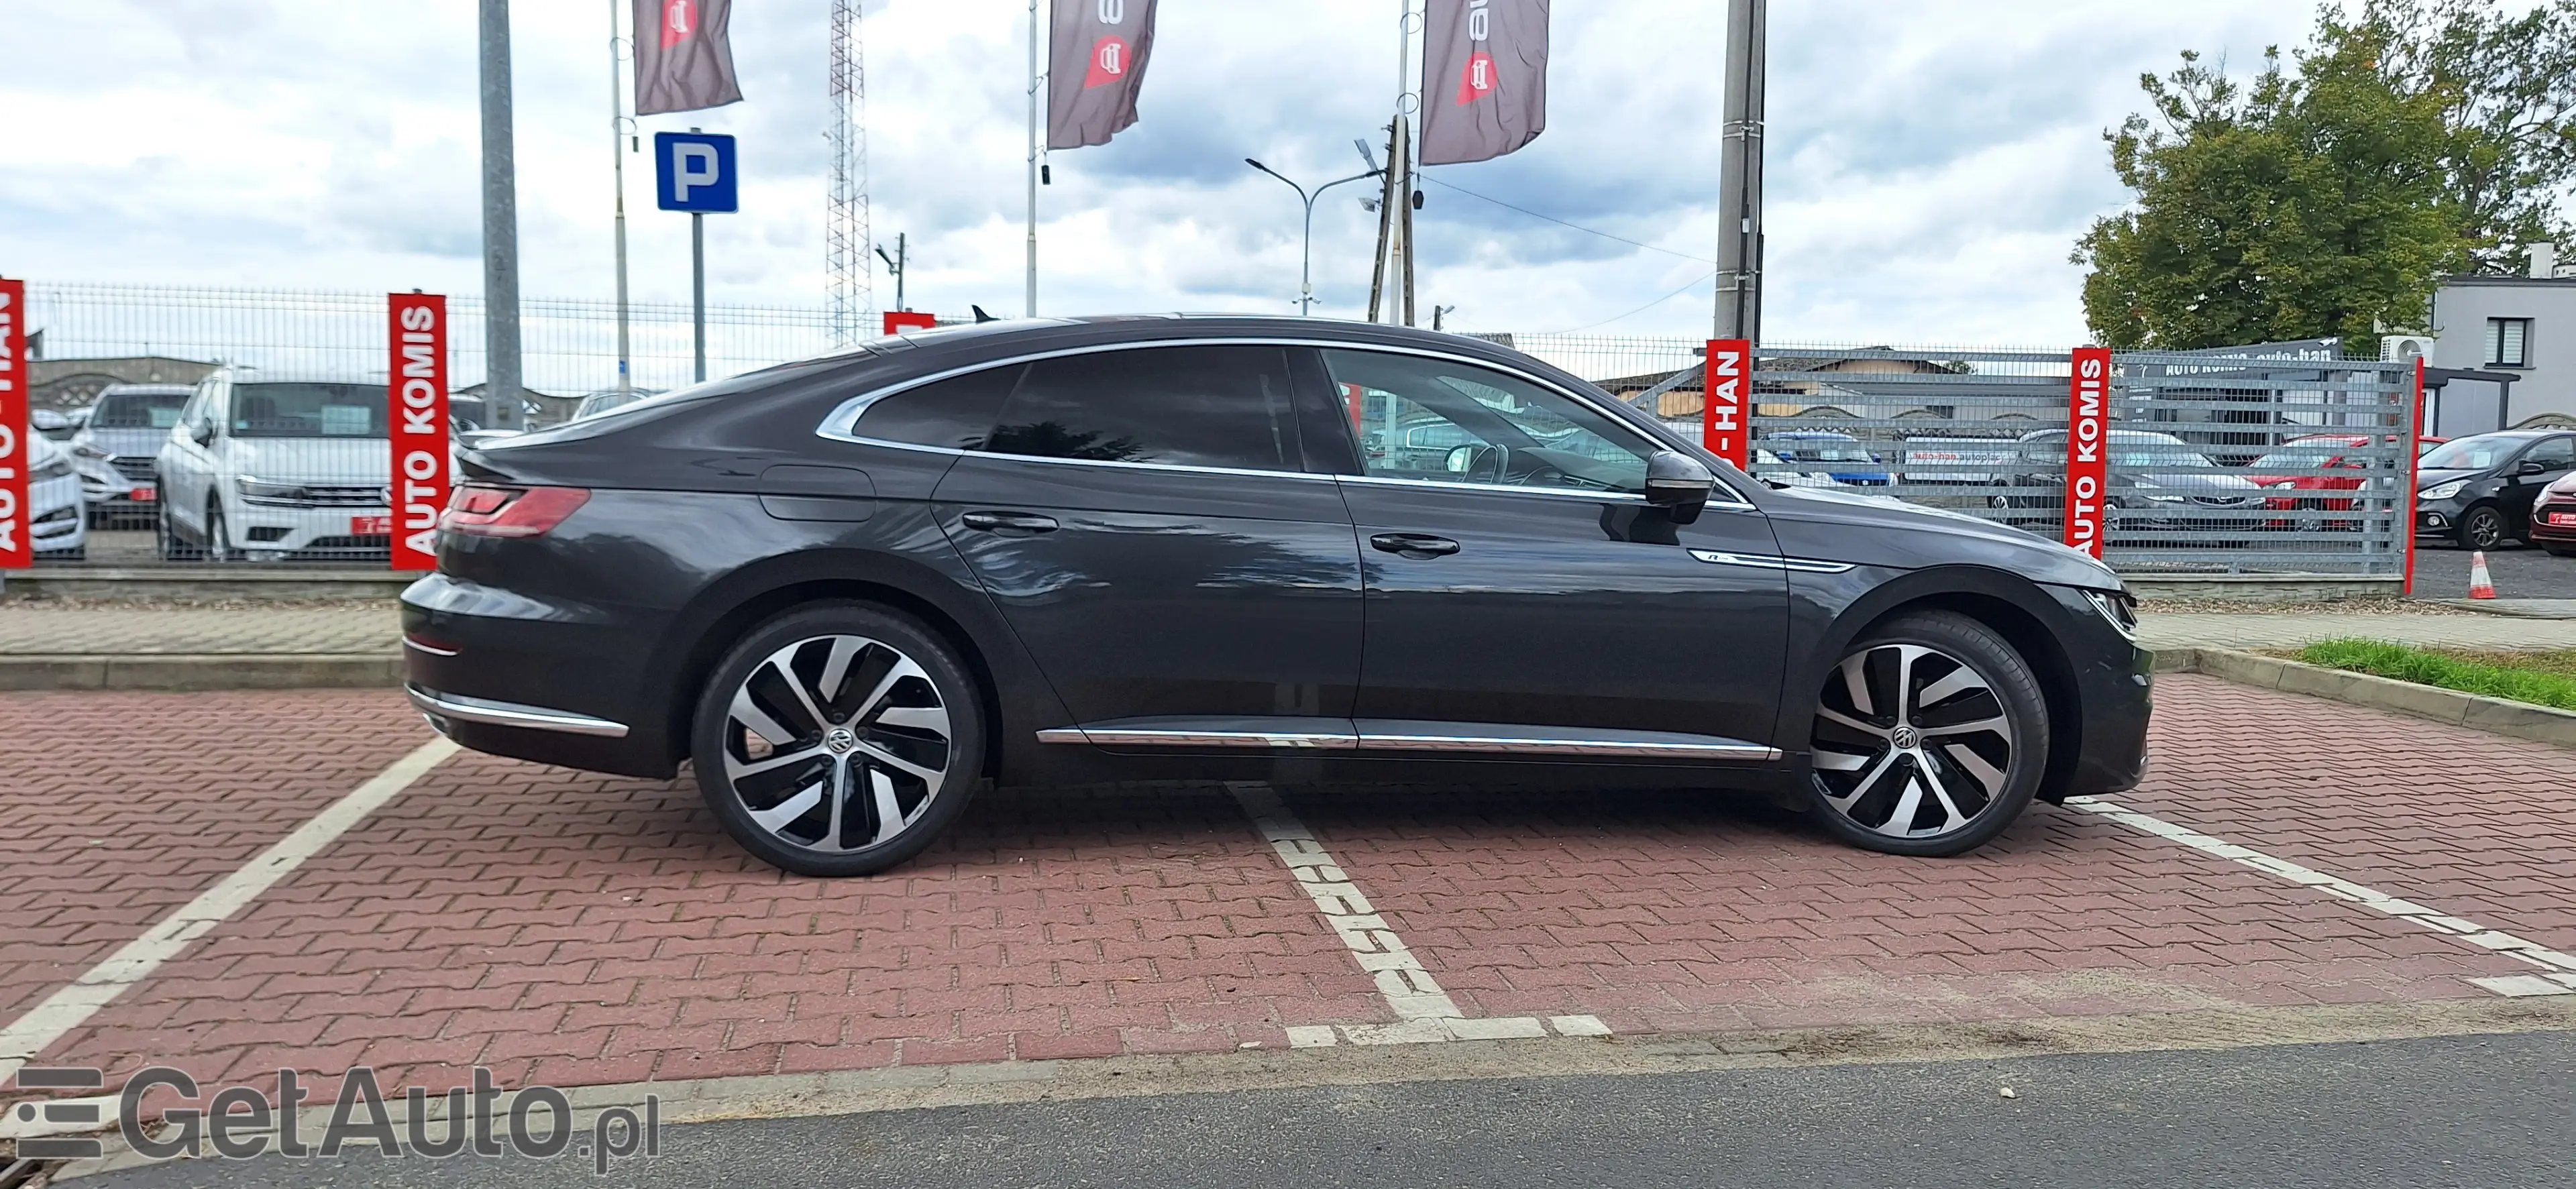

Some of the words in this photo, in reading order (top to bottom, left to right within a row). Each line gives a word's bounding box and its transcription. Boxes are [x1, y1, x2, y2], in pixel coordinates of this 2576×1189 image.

[672, 142, 719, 202] P
[401, 306, 436, 434] KOMIS
[1715, 351, 1739, 431] HAN
[2077, 358, 2101, 462] KOMIS
[405, 450, 437, 557] AUTO
[2073, 475, 2096, 559] AUTO
